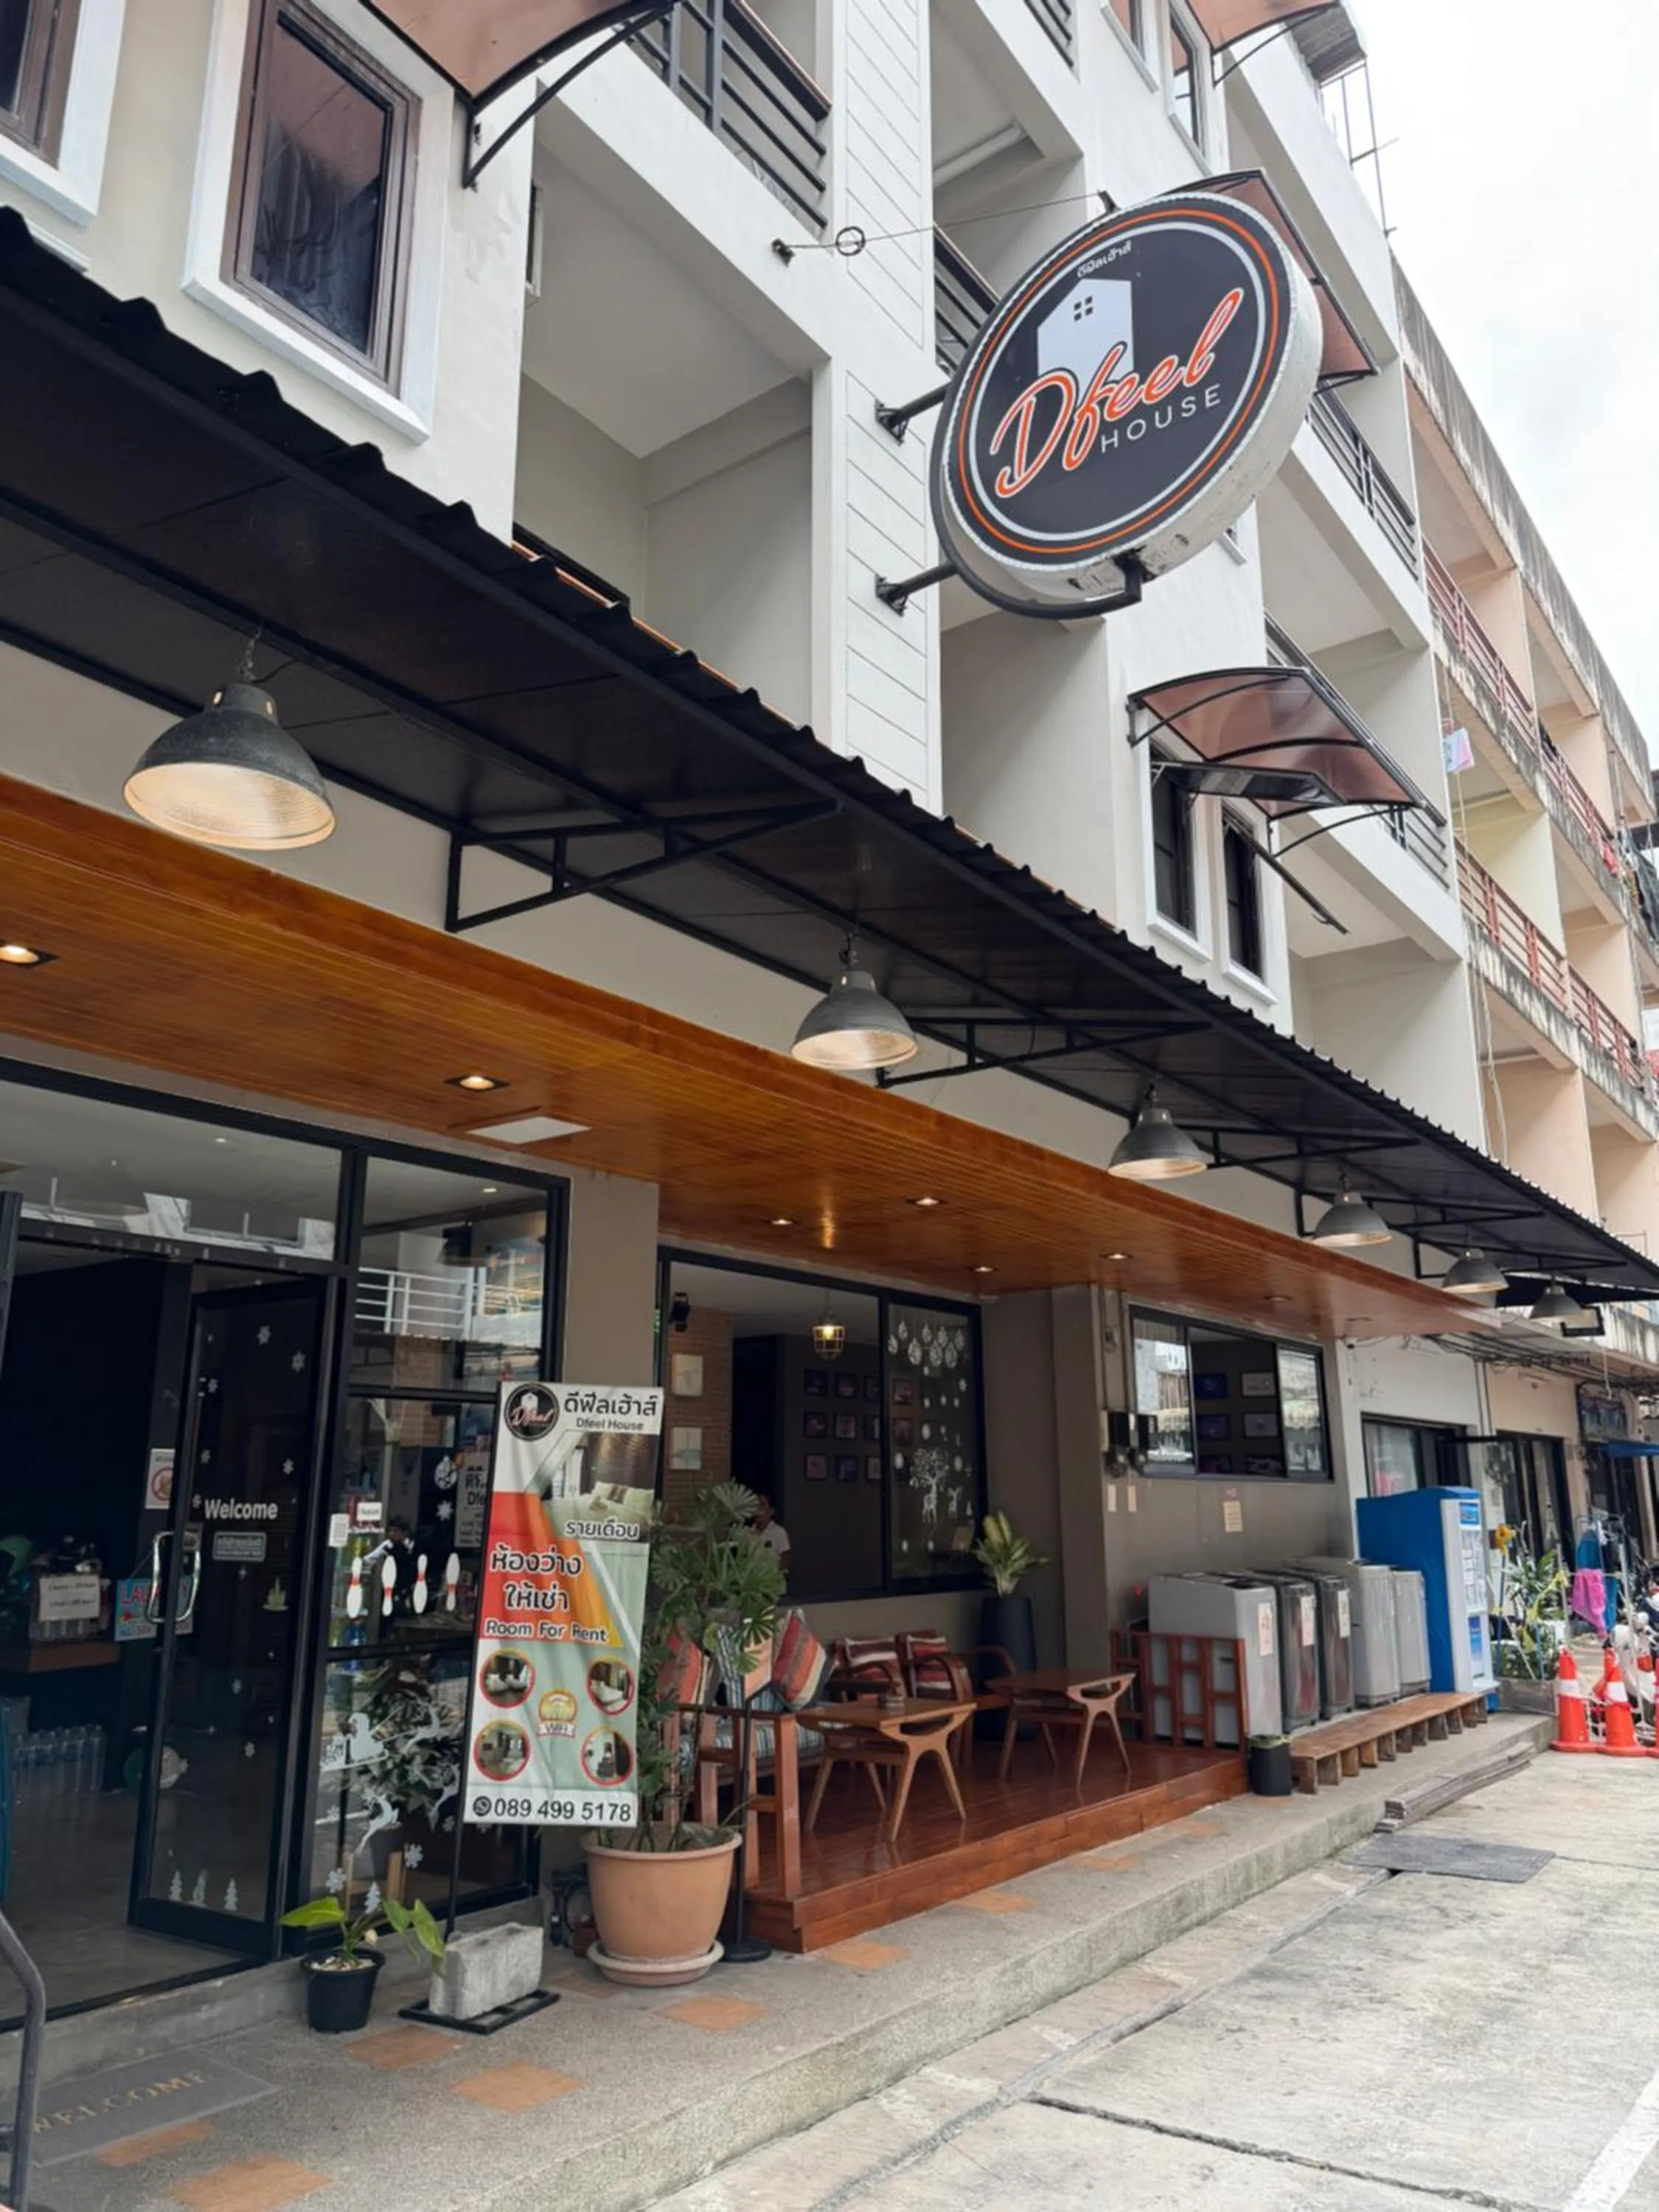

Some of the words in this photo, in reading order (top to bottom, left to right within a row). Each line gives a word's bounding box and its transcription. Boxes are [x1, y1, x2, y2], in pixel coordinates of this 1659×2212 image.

[989, 287, 1245, 498] Dfeel
[1100, 383, 1222, 454] HOUSE
[564, 1391, 658, 1416] ดีฟีลเฮ้าส์
[576, 1416, 606, 1428] Dfeel
[607, 1419, 644, 1430] House
[204, 1498, 279, 1520] Welcome
[566, 1518, 639, 1539] รายเดือน
[491, 1544, 582, 1575] ห้องว่าง
[504, 1582, 569, 1610] ให้เช่า
[486, 1621, 532, 1635] Room
[539, 1622, 565, 1637] For
[571, 1624, 607, 1642] Rent
[494, 1798, 532, 1817] 089
[537, 1799, 575, 1820] 499
[580, 1802, 632, 1822] 5178
